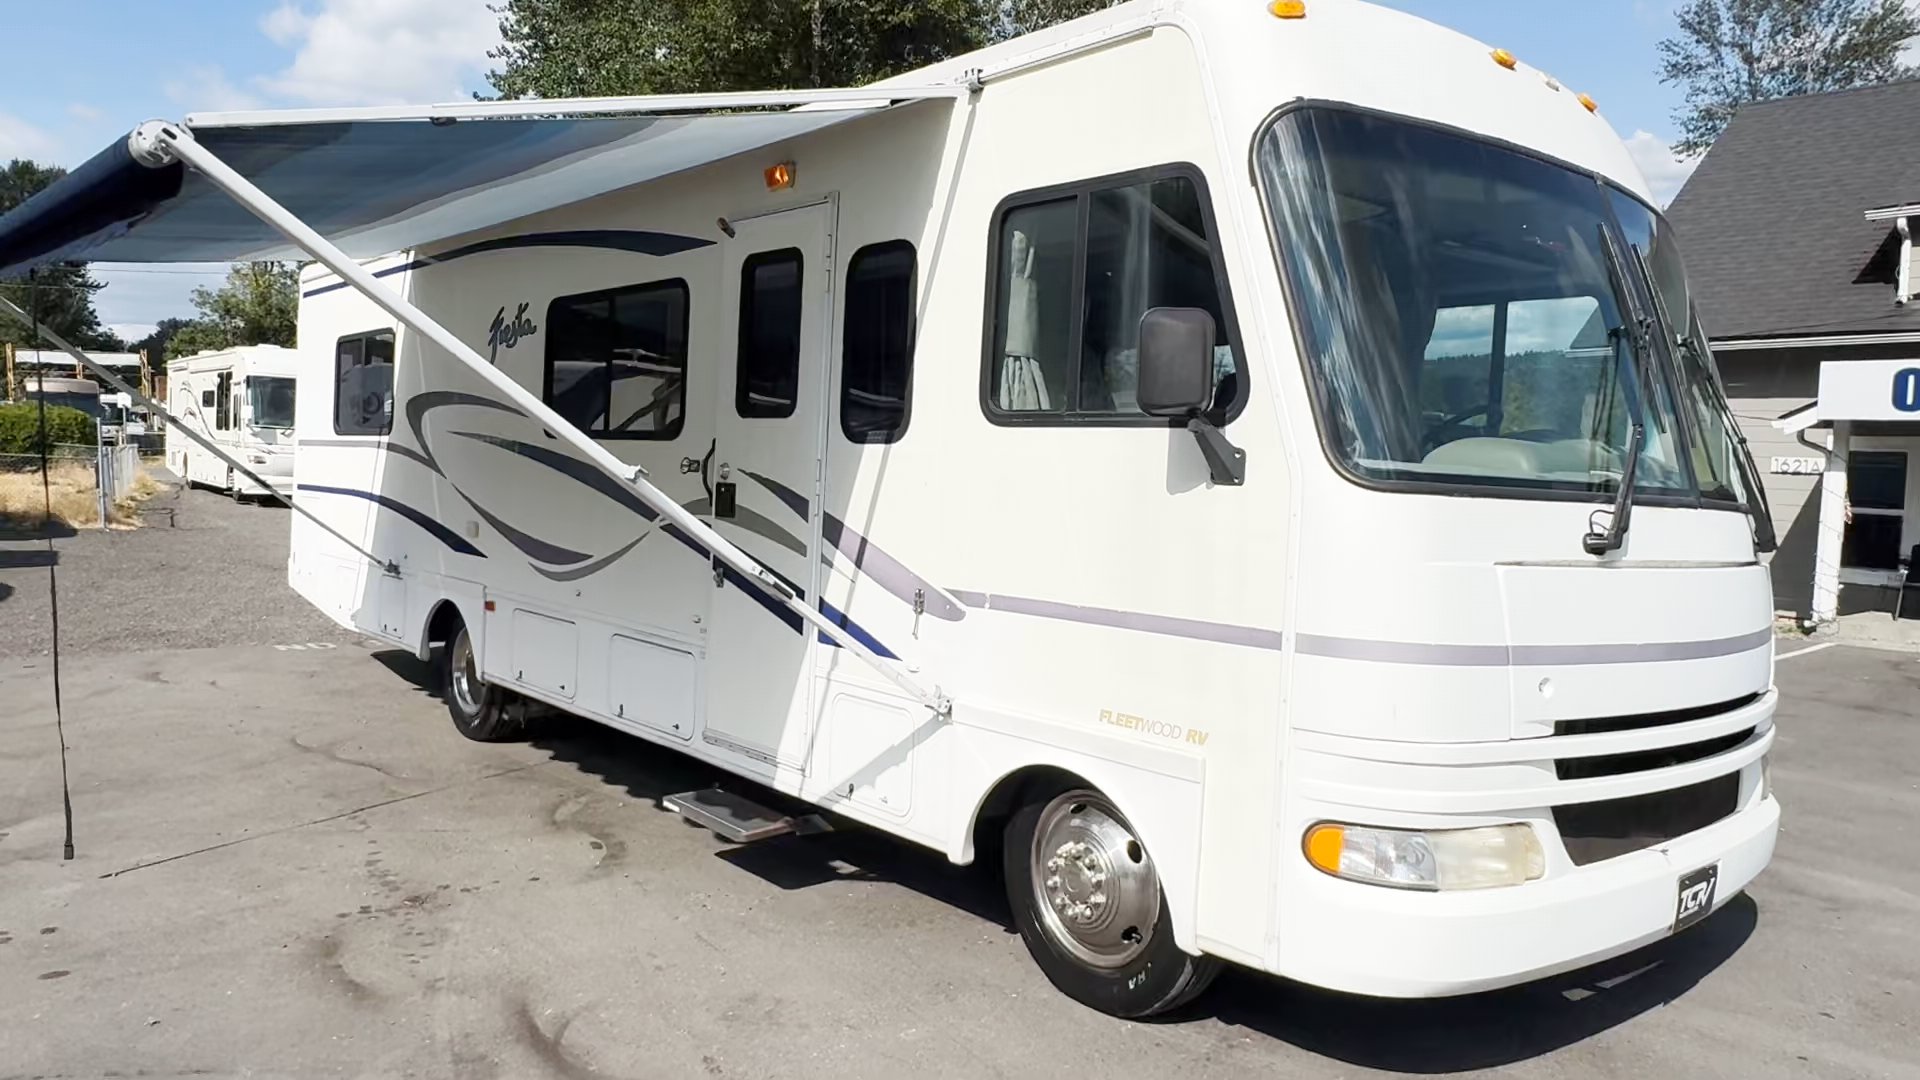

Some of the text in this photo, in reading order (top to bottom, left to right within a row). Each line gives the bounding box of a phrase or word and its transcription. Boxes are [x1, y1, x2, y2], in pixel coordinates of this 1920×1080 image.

[1774, 458, 1822, 473] 1621A
[1099, 709, 1209, 745] FLEETWOOD RV
